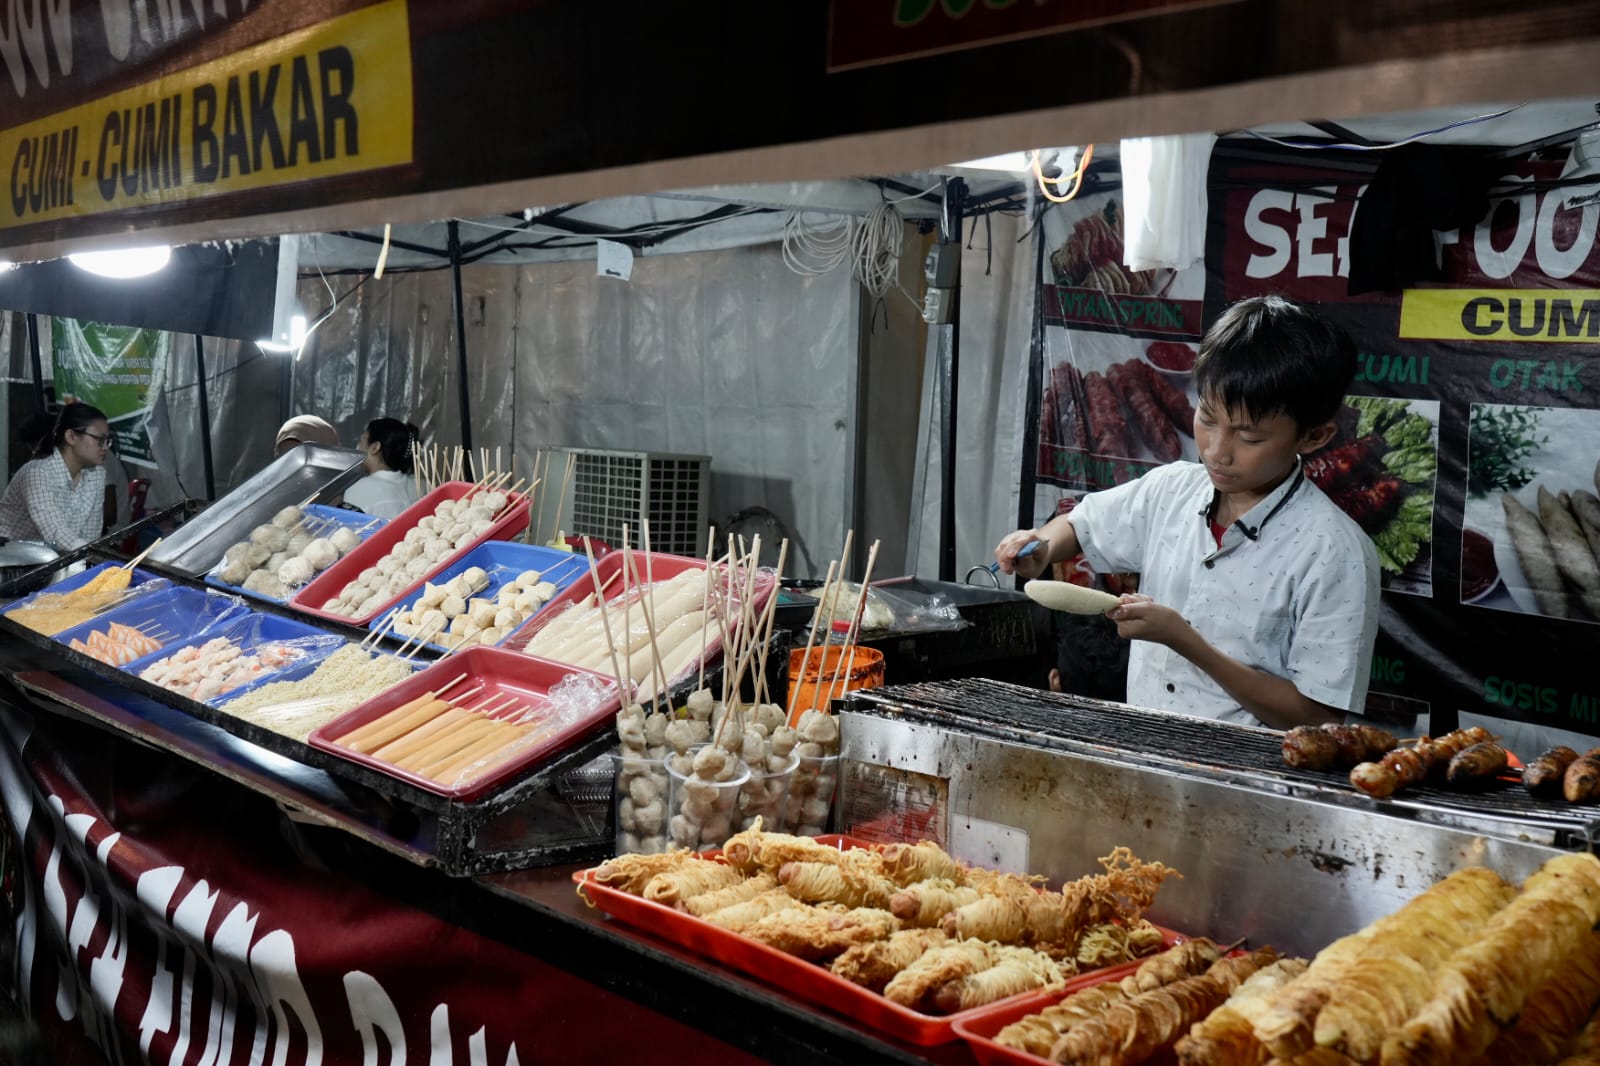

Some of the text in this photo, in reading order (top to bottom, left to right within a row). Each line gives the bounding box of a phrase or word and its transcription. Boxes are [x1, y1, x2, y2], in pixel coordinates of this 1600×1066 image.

[11, 126, 78, 217] CUMI
[97, 94, 182, 202] CUMI
[193, 46, 359, 184] BAKAR
[1243, 174, 1600, 280] SEOO
[1118, 299, 1186, 330] SPRING
[1461, 297, 1600, 337] CUM
[1489, 358, 1585, 393] OTAK
[1484, 676, 1559, 714] SOSIS
